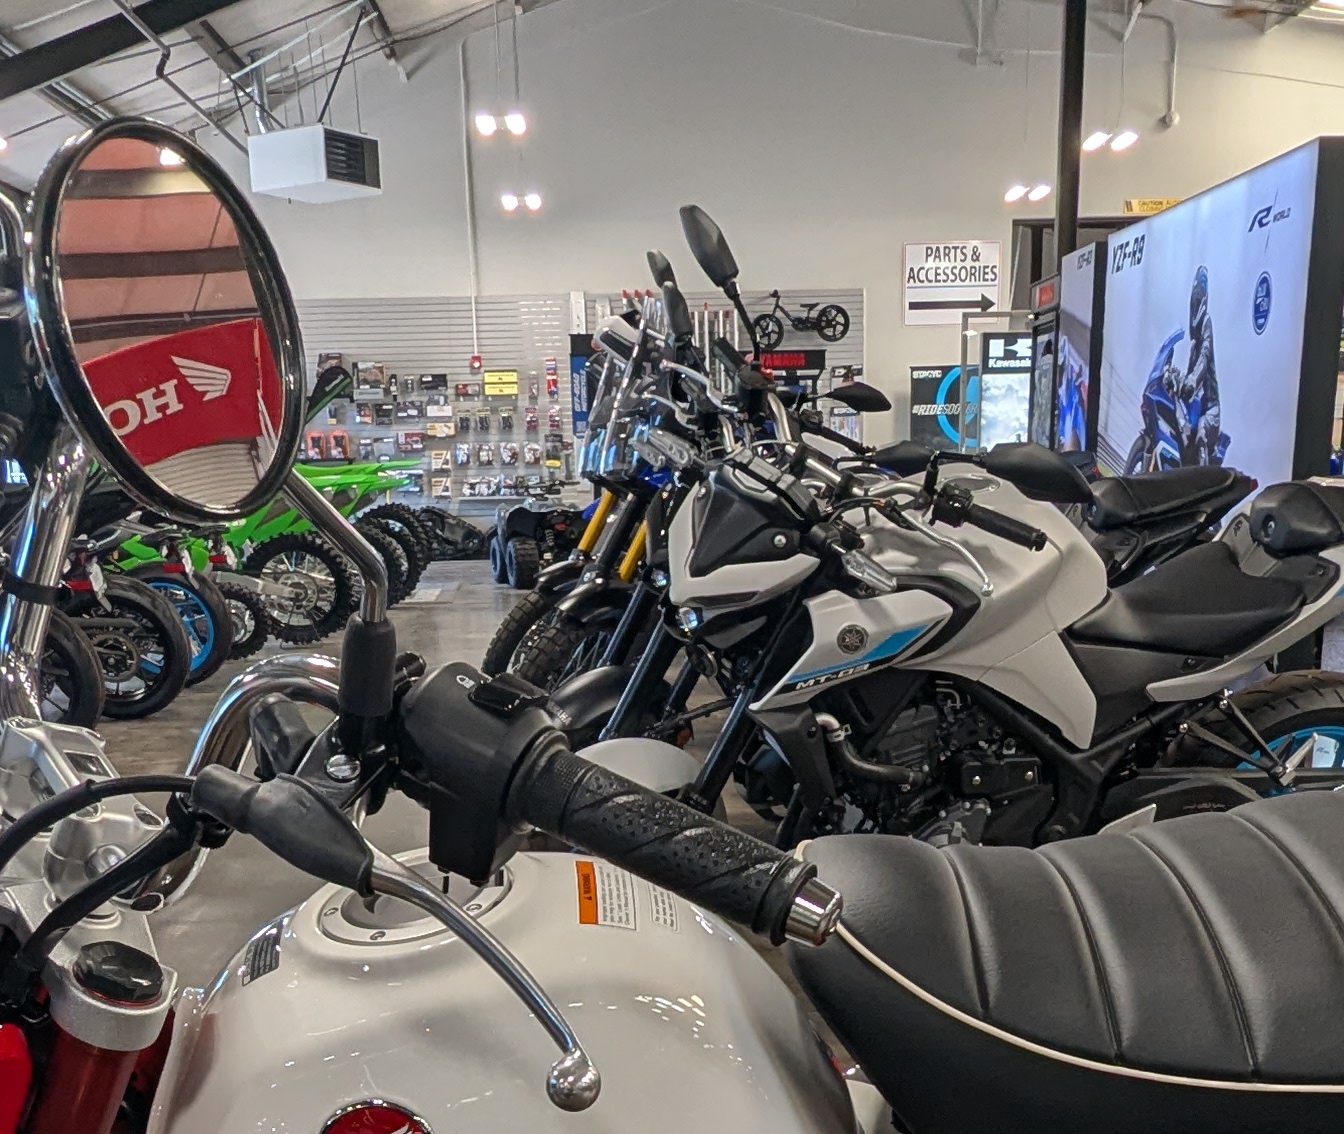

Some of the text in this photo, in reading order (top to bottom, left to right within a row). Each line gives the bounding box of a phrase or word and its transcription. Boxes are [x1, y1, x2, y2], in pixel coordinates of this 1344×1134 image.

[925, 244, 981, 263] PARTS &
[1111, 233, 1146, 275] YZF-R9
[907, 265, 998, 284] ACCESSORIES
[795, 662, 871, 690] MT-03
